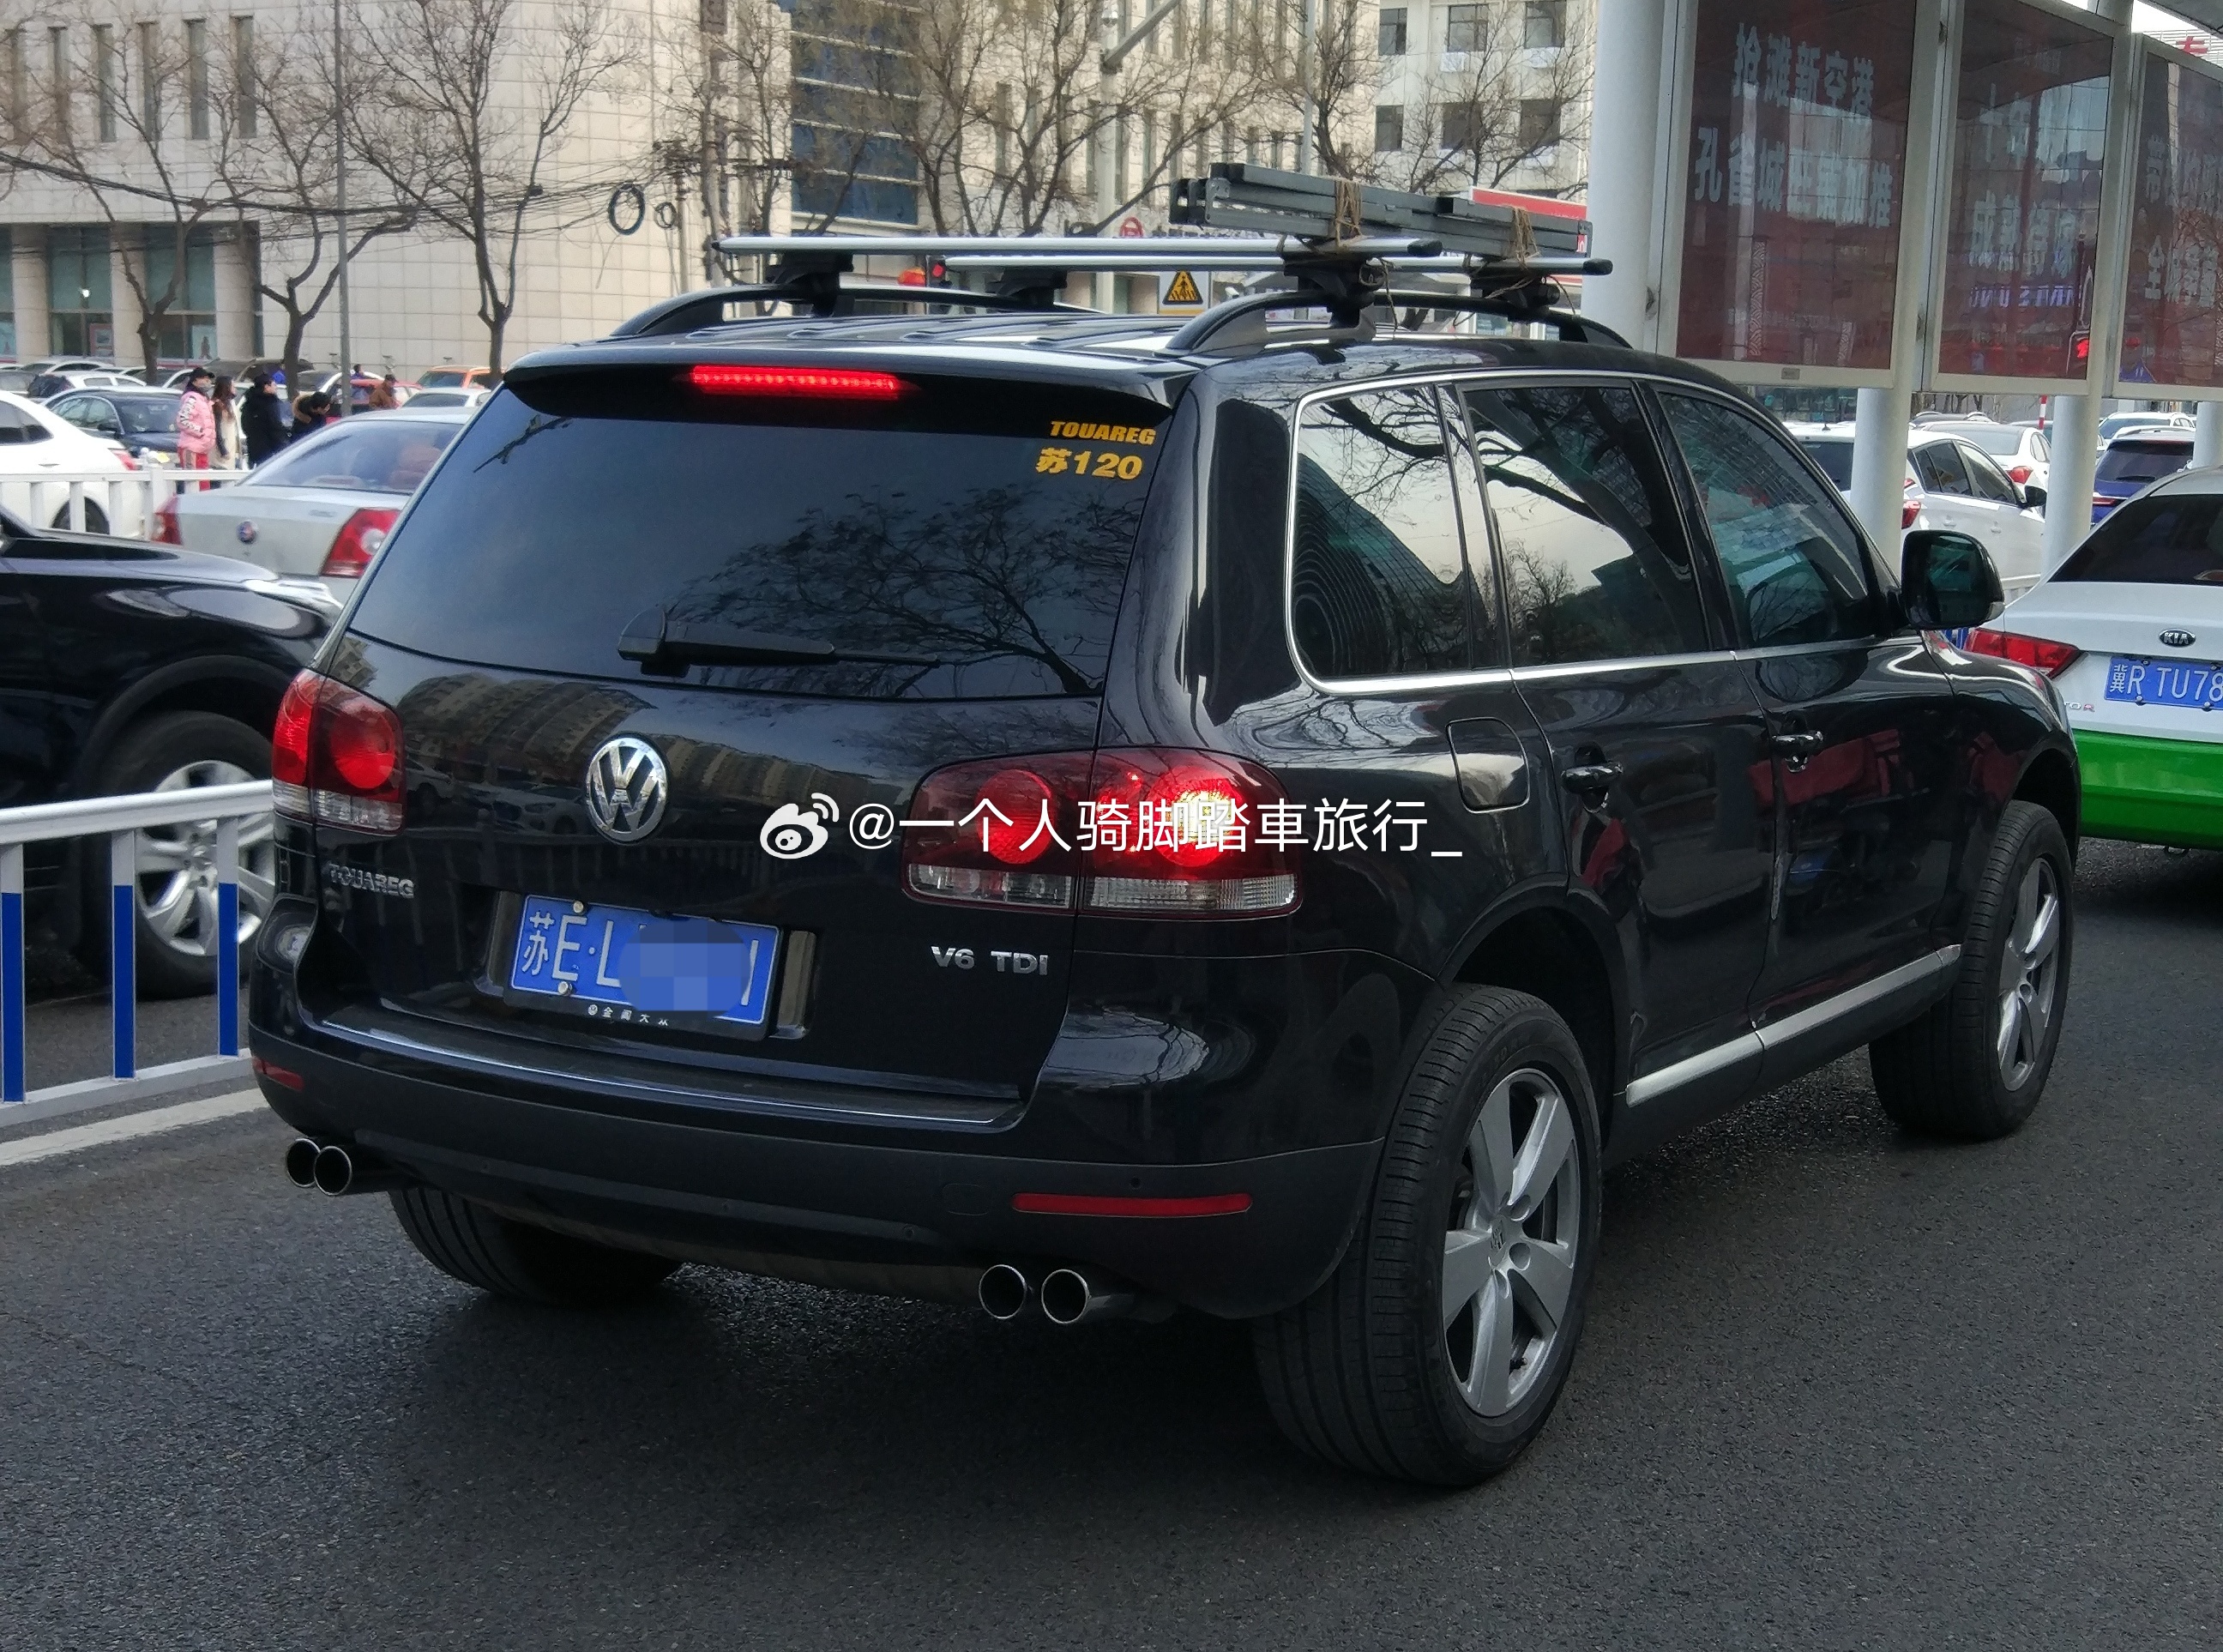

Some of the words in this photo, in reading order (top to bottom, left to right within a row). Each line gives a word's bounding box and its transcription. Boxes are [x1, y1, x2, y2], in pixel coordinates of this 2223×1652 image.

[1051, 420, 1157, 445] TOUAREG
[2163, 632, 2189, 644] KIA
[328, 862, 414, 899] TOUAREG
[931, 945, 975, 969] V6
[991, 950, 1048, 976] TDI
